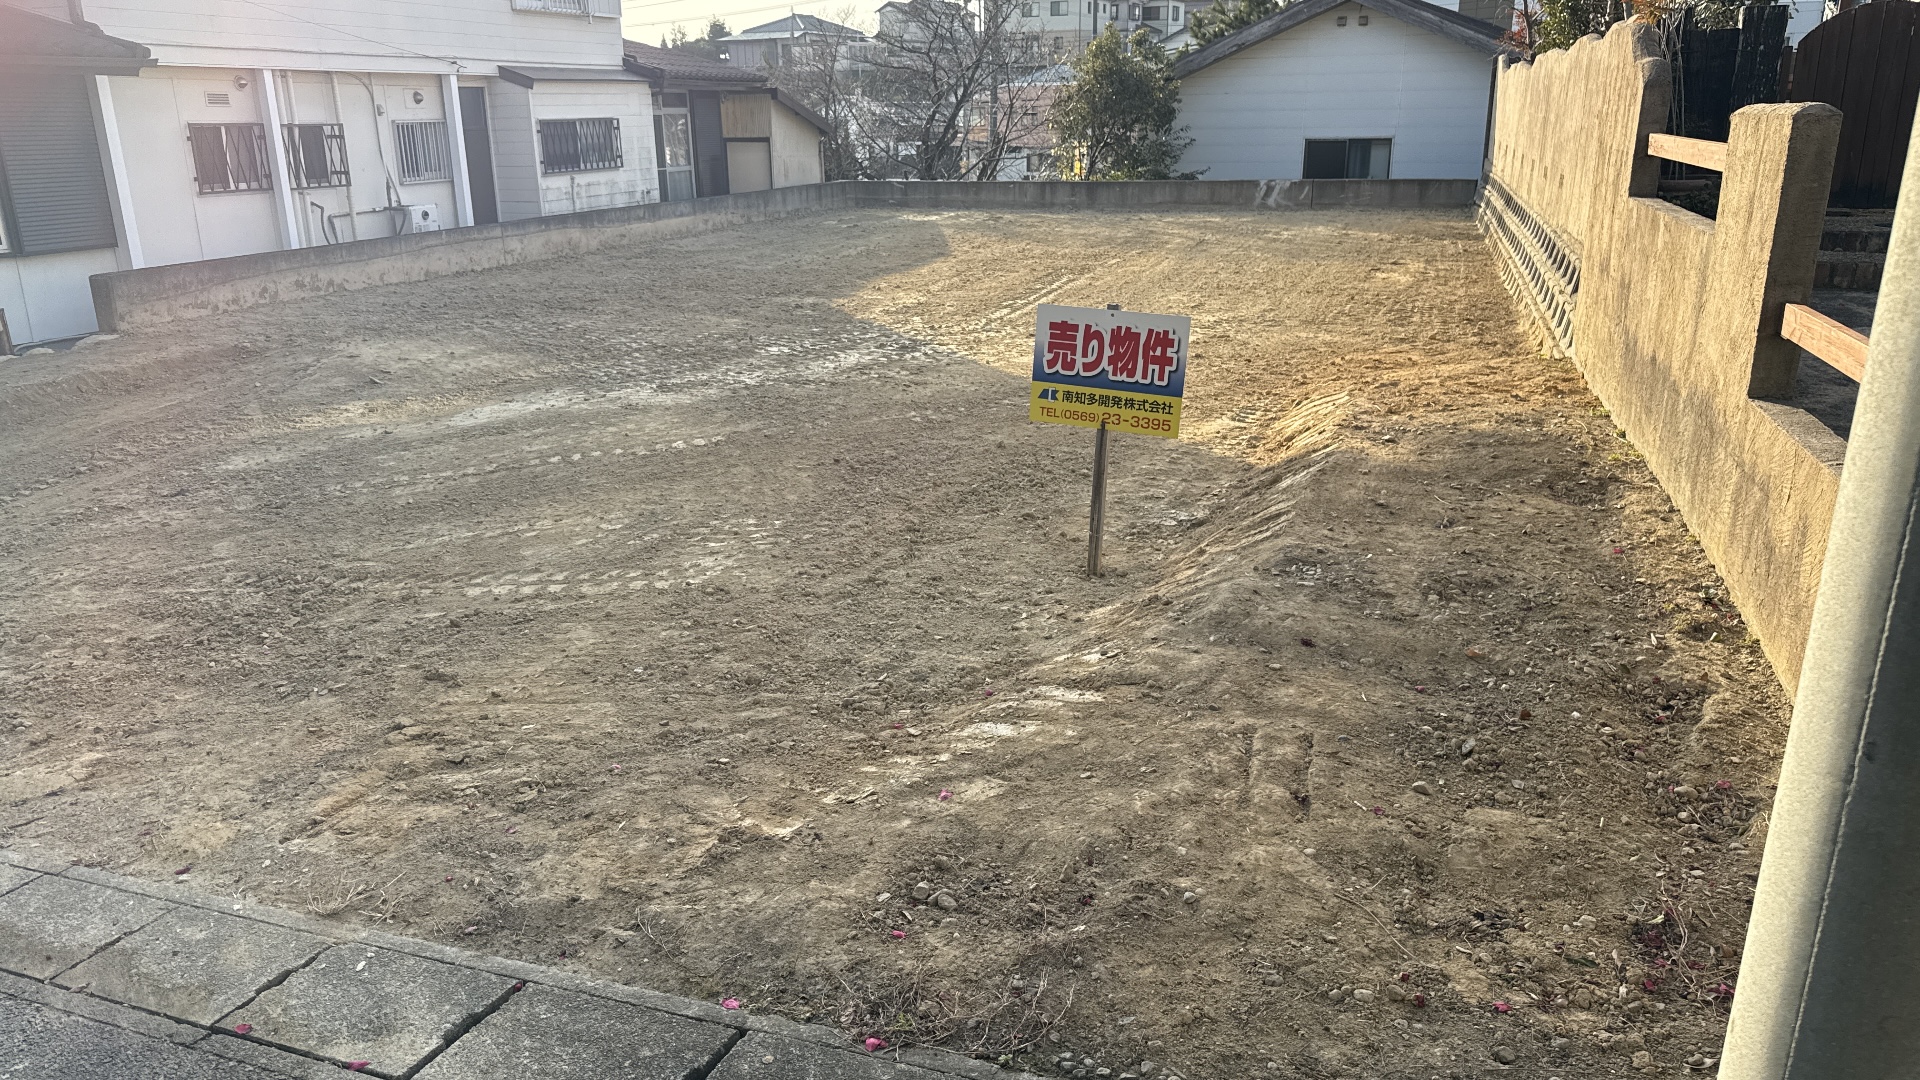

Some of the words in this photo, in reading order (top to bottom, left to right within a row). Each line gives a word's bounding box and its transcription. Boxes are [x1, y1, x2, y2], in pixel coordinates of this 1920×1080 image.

[1046, 320, 1175, 382] 売り物件
[1062, 390, 1174, 415] 南知多開発株式会社
